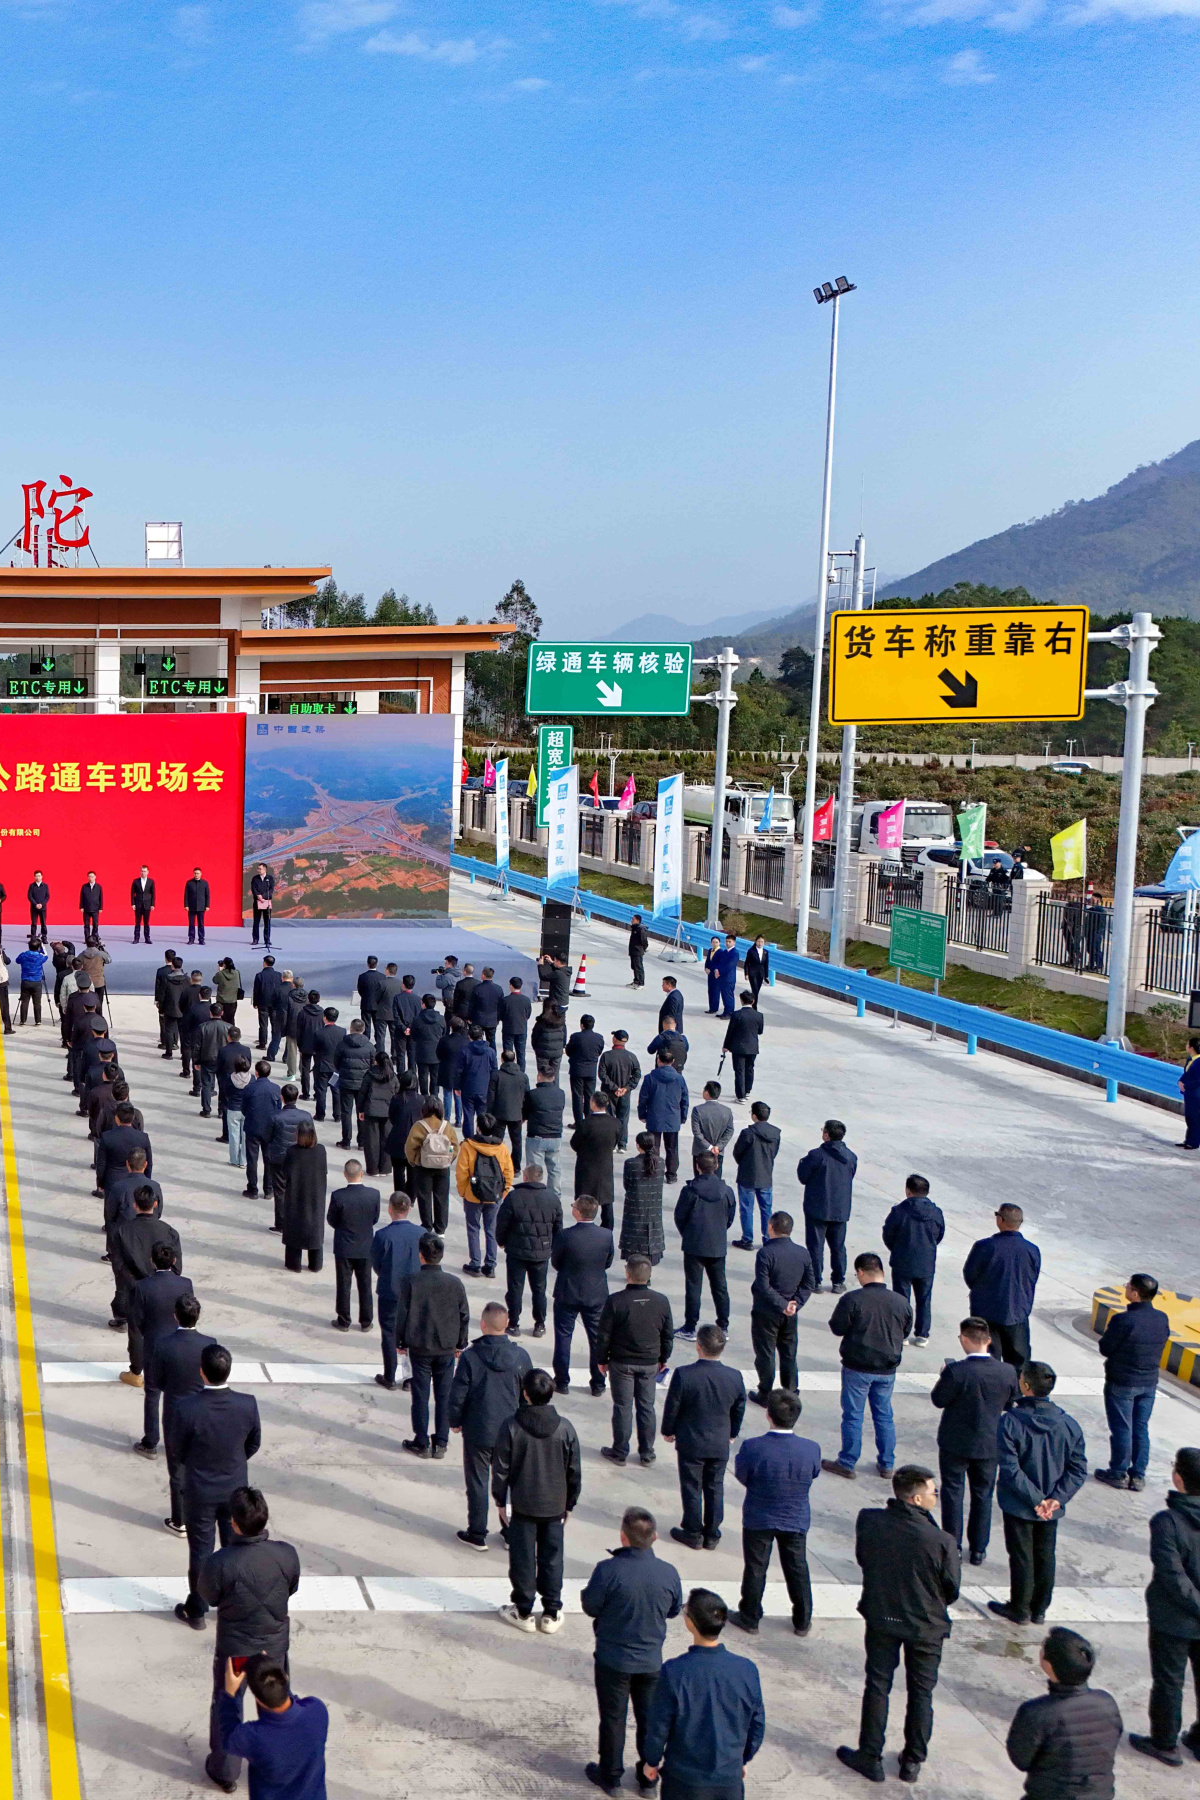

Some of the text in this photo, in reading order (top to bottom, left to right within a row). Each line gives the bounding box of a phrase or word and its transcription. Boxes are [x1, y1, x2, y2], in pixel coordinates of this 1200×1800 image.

[844, 621, 1076, 659] 货车称重靠右
[535, 651, 685, 674] 绿通车辆核验
[9, 680, 71, 695] ETC专用
[149, 680, 211, 694] ETC专用
[289, 702, 336, 715] 自助取卡
